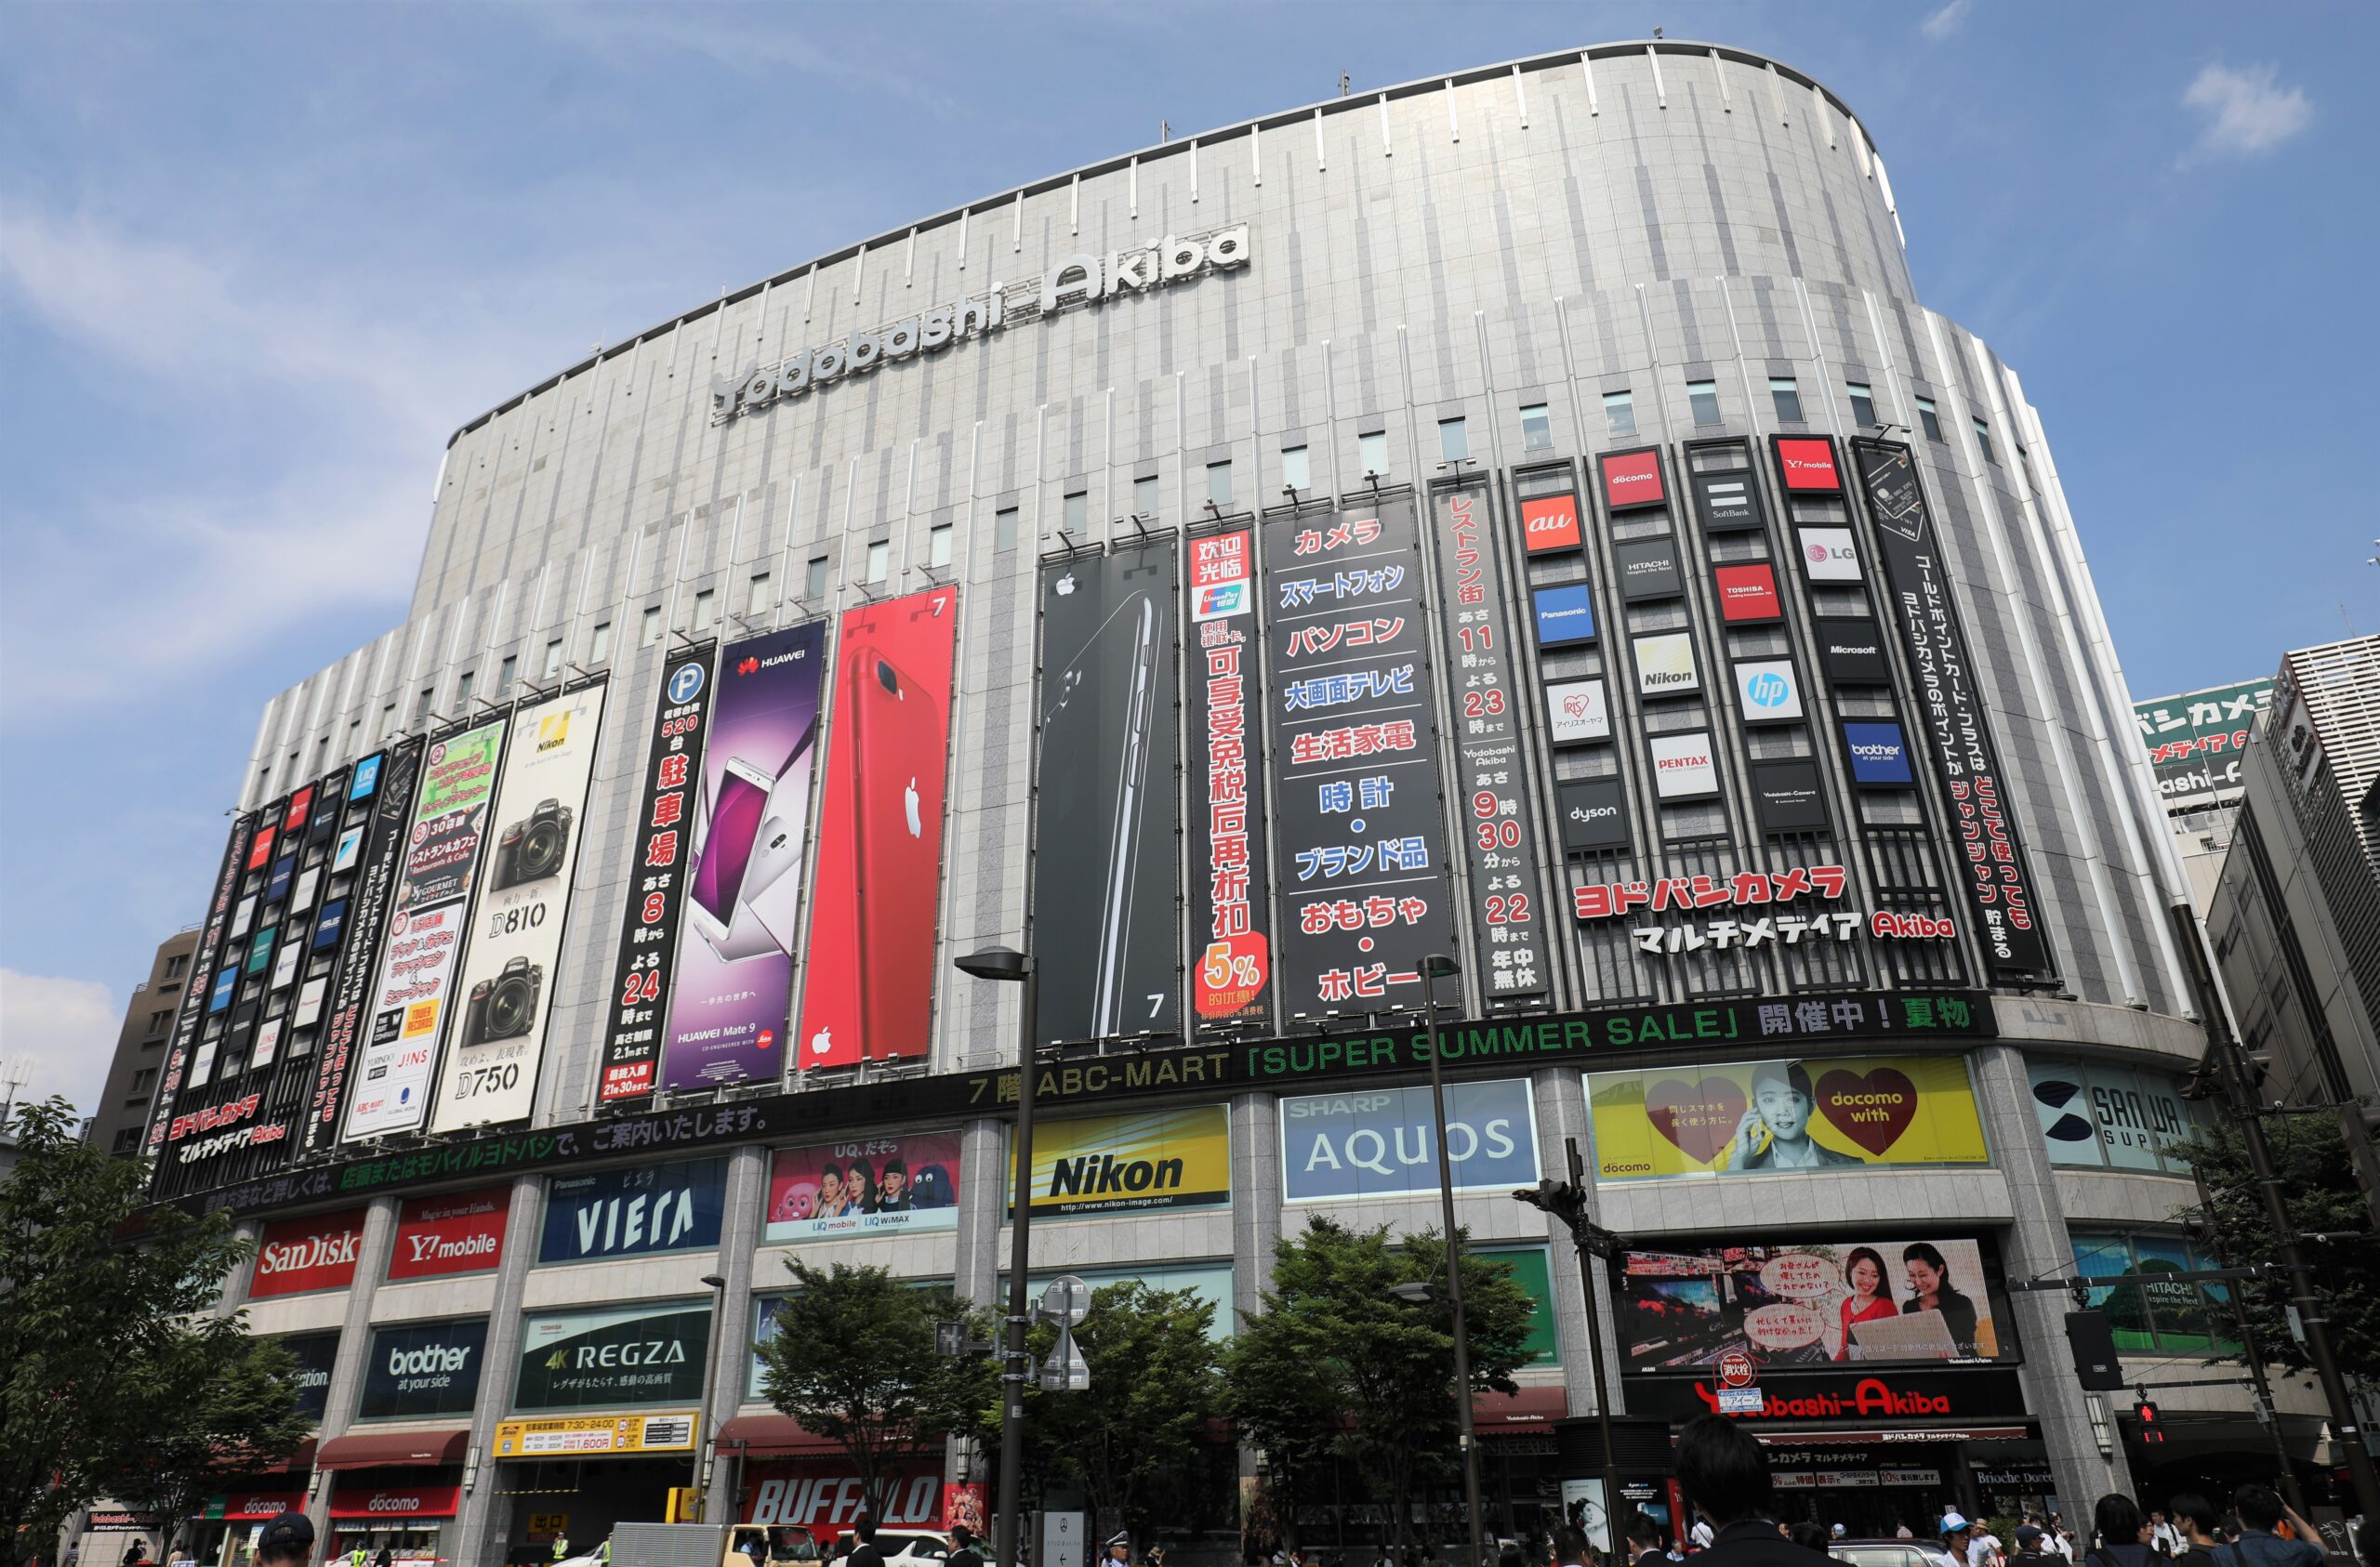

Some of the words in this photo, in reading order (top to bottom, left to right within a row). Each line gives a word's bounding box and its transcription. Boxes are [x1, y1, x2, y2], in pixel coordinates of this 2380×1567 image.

[711, 225, 1250, 415] Yodobashi-Akiba
[1712, 508, 1750, 519] SoftBank
[1528, 513, 1572, 533] au
[1900, 526, 1916, 537] VISA
[1294, 519, 1382, 556] カメラ
[1198, 536, 1241, 560] 欢迎
[1449, 495, 1484, 605] レストラン街
[1199, 559, 1242, 583] 光临
[1628, 560, 1670, 571] HITACHI
[1279, 565, 1405, 609] スマートフォン
[1726, 586, 1764, 594] TOSHIBA
[1203, 591, 1238, 603] UnionPay
[932, 597, 947, 618] 7
[1458, 609, 1489, 624] あさ
[1541, 608, 1587, 619] Panasonic
[1286, 616, 1405, 657] パソコン
[1458, 624, 1494, 652] 11
[760, 649, 805, 669] HUAWEI
[1831, 645, 1877, 655] Microsoft
[1461, 653, 1497, 668] 時から
[1465, 672, 1498, 688] よる
[1645, 671, 1692, 686] Nikon
[1285, 664, 1414, 712] 大画面テレビ
[1754, 674, 1783, 706] hp
[1463, 689, 1506, 718] 23
[661, 715, 698, 737] 520
[1468, 718, 1504, 734] 時まで
[1555, 717, 1603, 729] アイリスオーヤマ
[536, 737, 565, 753] Nikon
[669, 736, 683, 751] 台
[1291, 719, 1416, 764] 生活家電
[1851, 744, 1900, 756] brother
[1463, 744, 1516, 759] Yodobashi
[1475, 756, 1507, 767] Akiba
[1658, 756, 1708, 770] PENTAX
[1475, 770, 1509, 787] あさ
[1206, 645, 1250, 939] 可享受免税后再折扣
[1319, 775, 1394, 814] 時計
[645, 753, 689, 866] 駐車場
[1570, 806, 1617, 823] dyson
[1476, 819, 1521, 851] 30
[412, 859, 445, 875] Restaurants
[1295, 836, 1429, 882] ブランド品
[1483, 852, 1520, 869] 分から
[642, 873, 672, 891] あさ
[1488, 874, 1522, 891] よる
[1573, 864, 1846, 918] ヨドバシカメラ
[641, 892, 665, 924] 8
[1301, 895, 1427, 935] おもちゃ
[1485, 892, 1531, 926] 22
[489, 902, 546, 939] D810
[633, 928, 664, 942] 時から
[1490, 927, 1529, 943] 時まで
[1633, 913, 1861, 954] マルチメディア
[1871, 912, 1955, 938] Akiba
[630, 952, 659, 970] よる
[1204, 942, 1260, 989] 5%
[1491, 948, 1534, 968] 年中
[622, 968, 659, 1006] 24
[1317, 962, 1421, 1002] ホビー
[1493, 968, 1538, 990] 無休
[700, 991, 756, 1006] 一歩先の世界へ
[1146, 994, 1165, 1020] 7
[621, 1007, 653, 1025] 時まで
[615, 1029, 653, 1046] 高さ制限
[677, 1028, 721, 1044] HUAWEI
[722, 1025, 747, 1037] Mate
[748, 1022, 756, 1034] 9
[613, 1046, 650, 1060] 2.1mまで
[702, 1041, 741, 1052] CO-ENGINEERED
[742, 1039, 755, 1047] WITH
[1035, 1051, 1230, 1098] ABC-MART
[1410, 1020, 1591, 1062] SUMMER
[608, 1065, 647, 1081] 最終入庫
[456, 1067, 519, 1100] D750
[1289, 1096, 1391, 1118] SHARP
[1831, 1089, 1903, 1107] docomo
[168, 1093, 261, 1141] ヨドバシカメラ
[1669, 1102, 1726, 1114] 同じスマホを
[1850, 1108, 1890, 1123] with
[1672, 1115, 1733, 1127] 長く使う方に。
[250, 1124, 286, 1145] Akiba
[1304, 1118, 1516, 1176] AQUOS
[554, 1176, 596, 1191] Panasonic
[1049, 1153, 1183, 1197] Nikon
[1061, 1195, 1173, 1212] http://www.nikon-image.com/
[420, 1209, 443, 1221] Magic
[443, 1208, 451, 1218] in
[452, 1207, 469, 1220] your
[577, 1187, 694, 1256] VIERA
[865, 1216, 879, 1227] UQ
[880, 1215, 910, 1225] WiMAX
[813, 1220, 826, 1231] UQ
[827, 1218, 857, 1230] mobile
[260, 1233, 361, 1276] SanDisk
[2146, 1282, 2192, 1296] HITACHI
[389, 1343, 469, 1376] brother
[545, 1349, 570, 1369] 4K
[576, 1340, 685, 1369] REGZA
[1724, 1363, 1749, 1376] 消火栓
[398, 1377, 408, 1391] at
[409, 1376, 430, 1393] your
[430, 1374, 450, 1389] side
[553, 1373, 673, 1389] レグザがもたらす、感動の高画質
[1882, 1432, 1925, 1441] ヨドバシカメラ
[1977, 1471, 2020, 1483] Brioche
[369, 1495, 419, 1512] docomo
[535, 1515, 562, 1529] 出口
